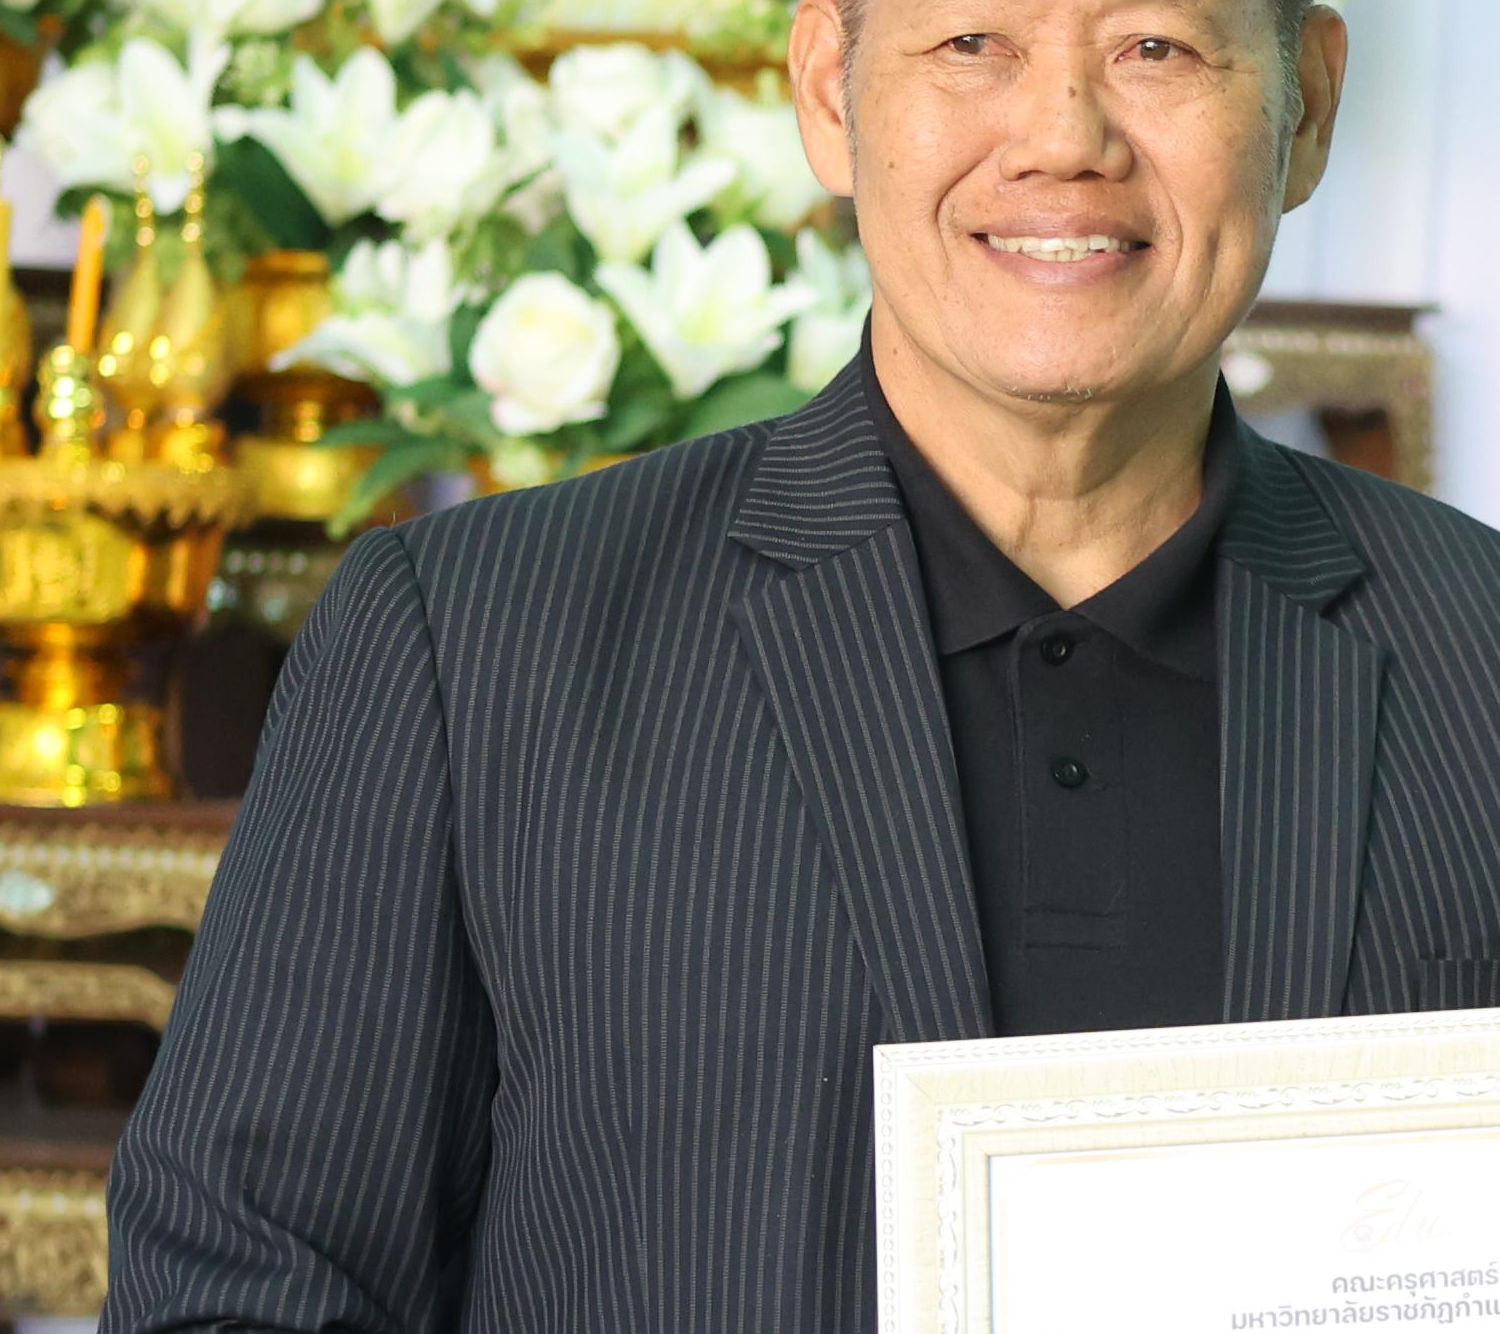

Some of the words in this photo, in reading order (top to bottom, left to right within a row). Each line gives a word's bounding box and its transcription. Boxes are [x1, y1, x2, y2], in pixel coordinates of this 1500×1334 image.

[1332, 1261, 1499, 1299] คณะครุศาสตร์
